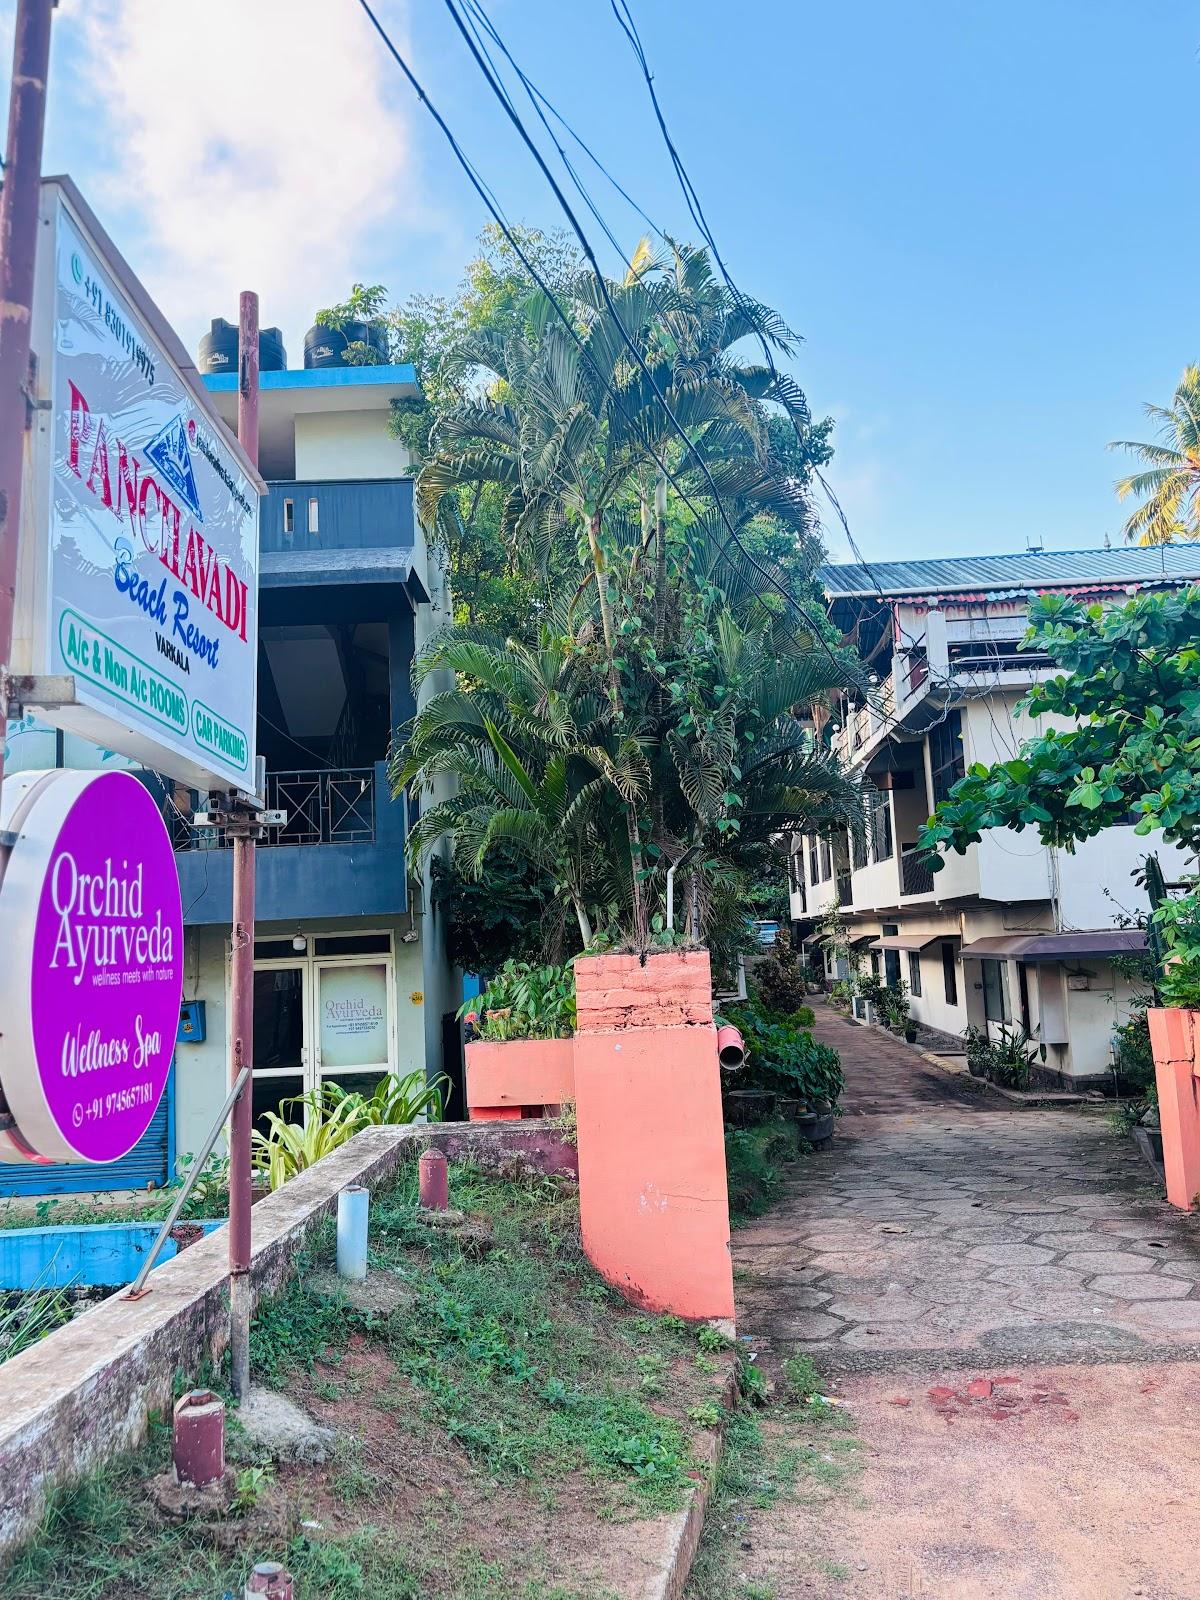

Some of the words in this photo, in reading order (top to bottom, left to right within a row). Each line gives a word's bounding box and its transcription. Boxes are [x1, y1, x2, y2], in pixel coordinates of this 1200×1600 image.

[84, 276, 102, 318] +91
[66, 379, 248, 644] PANCHAVADI
[114, 536, 168, 627] Beach
[173, 590, 219, 669] Resort
[67, 623, 89, 666] A/c
[92, 639, 102, 675] &
[104, 646, 127, 692] Non
[149, 677, 185, 727] ROOMS
[155, 631, 190, 676] VARKALA
[196, 710, 212, 741] CAR
[214, 721, 245, 764] PARKING
[51, 851, 143, 919] Orchid
[49, 905, 173, 986] Ayurveda
[92, 967, 120, 986] wellness
[122, 968, 141, 984] meets
[142, 964, 155, 982] with
[155, 966, 174, 980] nature
[325, 998, 364, 1010] Orchid
[326, 1005, 383, 1020] Ayurveda
[62, 1022, 130, 1078] Wellness
[133, 1014, 161, 1069] Spa
[85, 1097, 103, 1120] +91
[106, 1082, 153, 1116] 9745657181
